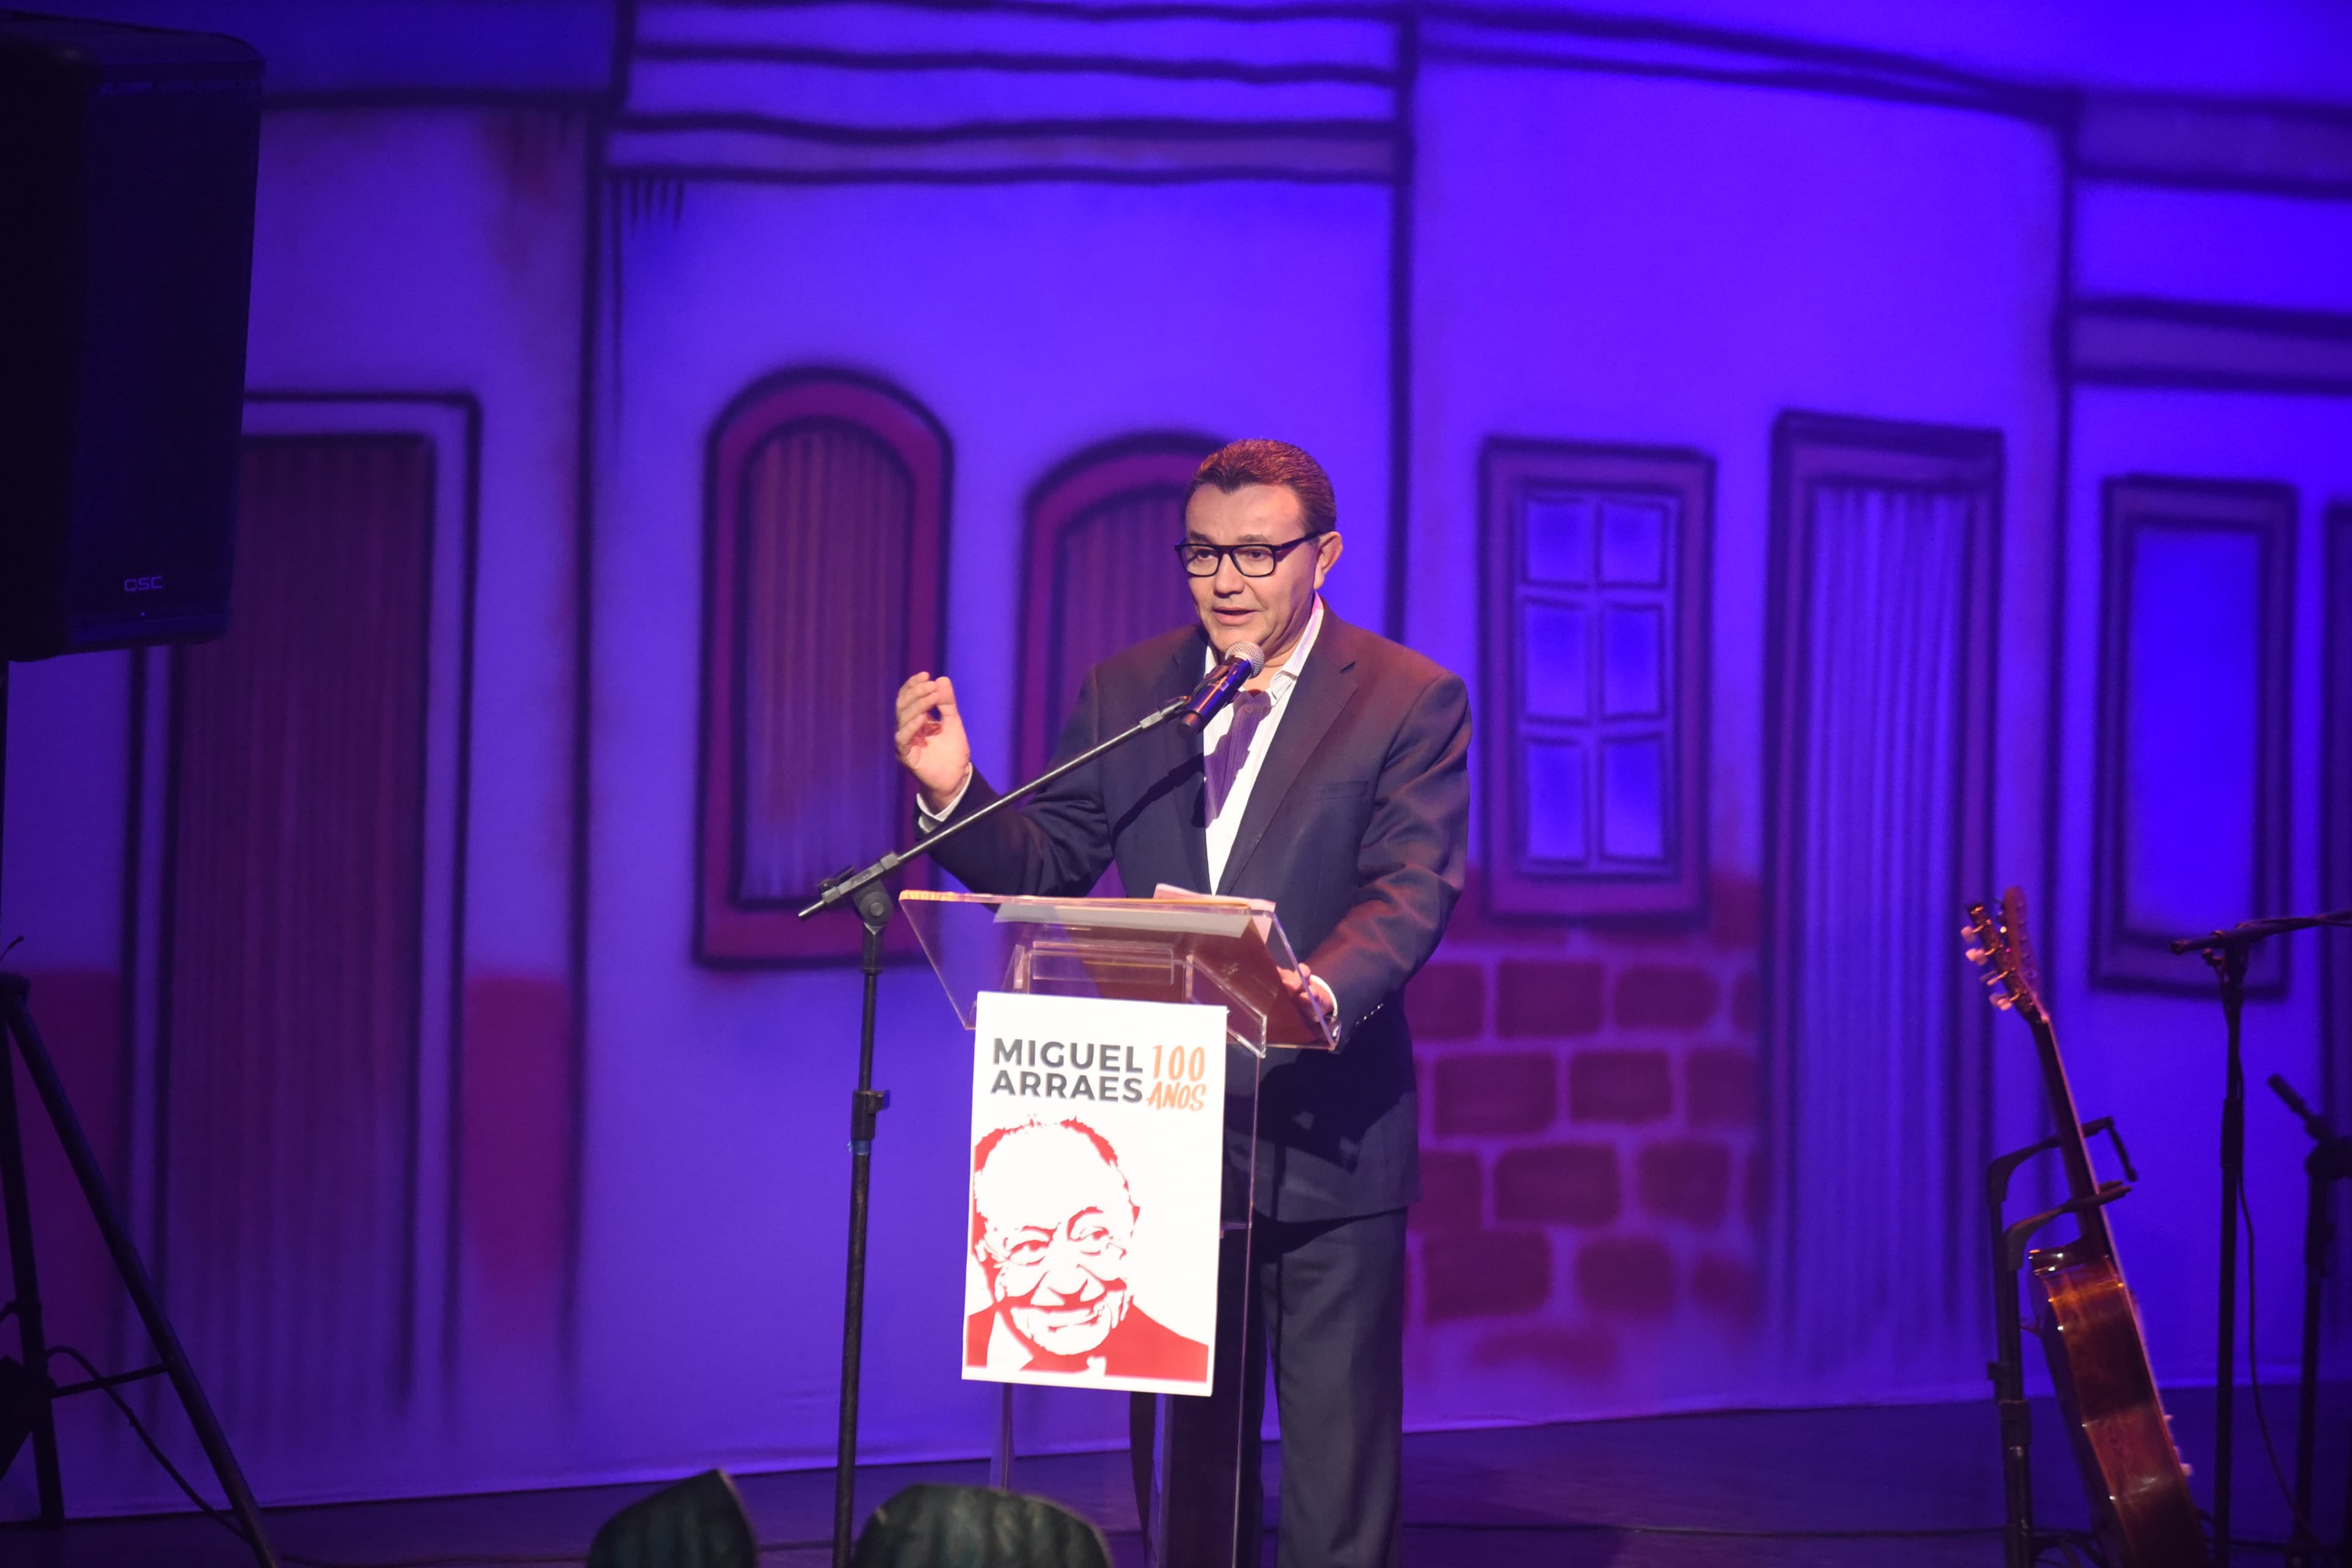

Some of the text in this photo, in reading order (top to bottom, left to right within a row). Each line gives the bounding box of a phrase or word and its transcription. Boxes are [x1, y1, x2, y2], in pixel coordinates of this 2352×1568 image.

[993, 1038, 1143, 1073] MIGUEL
[1153, 1045, 1205, 1082] 100
[990, 1069, 1143, 1103] ARRAES
[1147, 1081, 1206, 1112] ANOS
